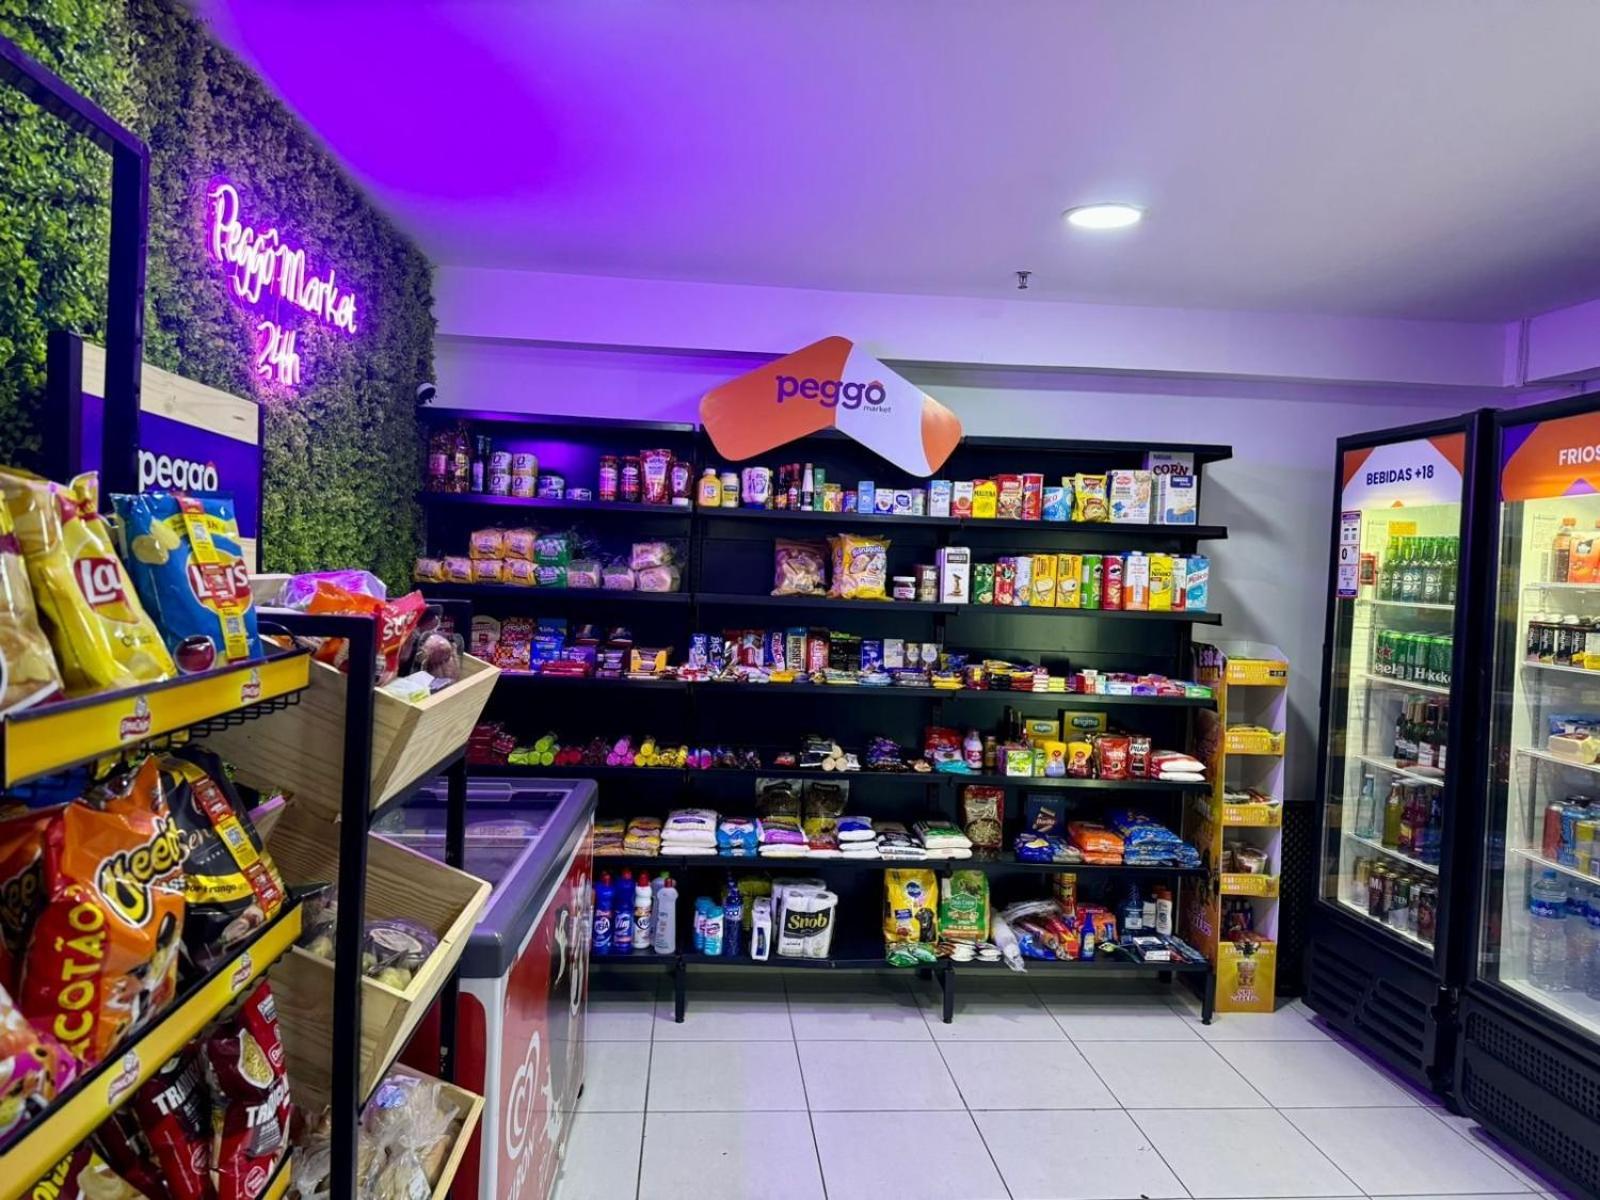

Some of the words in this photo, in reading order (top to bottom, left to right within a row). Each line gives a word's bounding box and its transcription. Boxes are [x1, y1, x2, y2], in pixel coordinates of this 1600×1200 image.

[275, 244, 357, 333] Market
[776, 375, 886, 410] peggô
[863, 405, 892, 414] market
[1153, 463, 1189, 476] CORN
[1366, 467, 1412, 485] BEBIDAS
[1415, 465, 1434, 479] +18
[787, 913, 828, 930] Snob
[54, 901, 107, 1061] ACOTÃO
